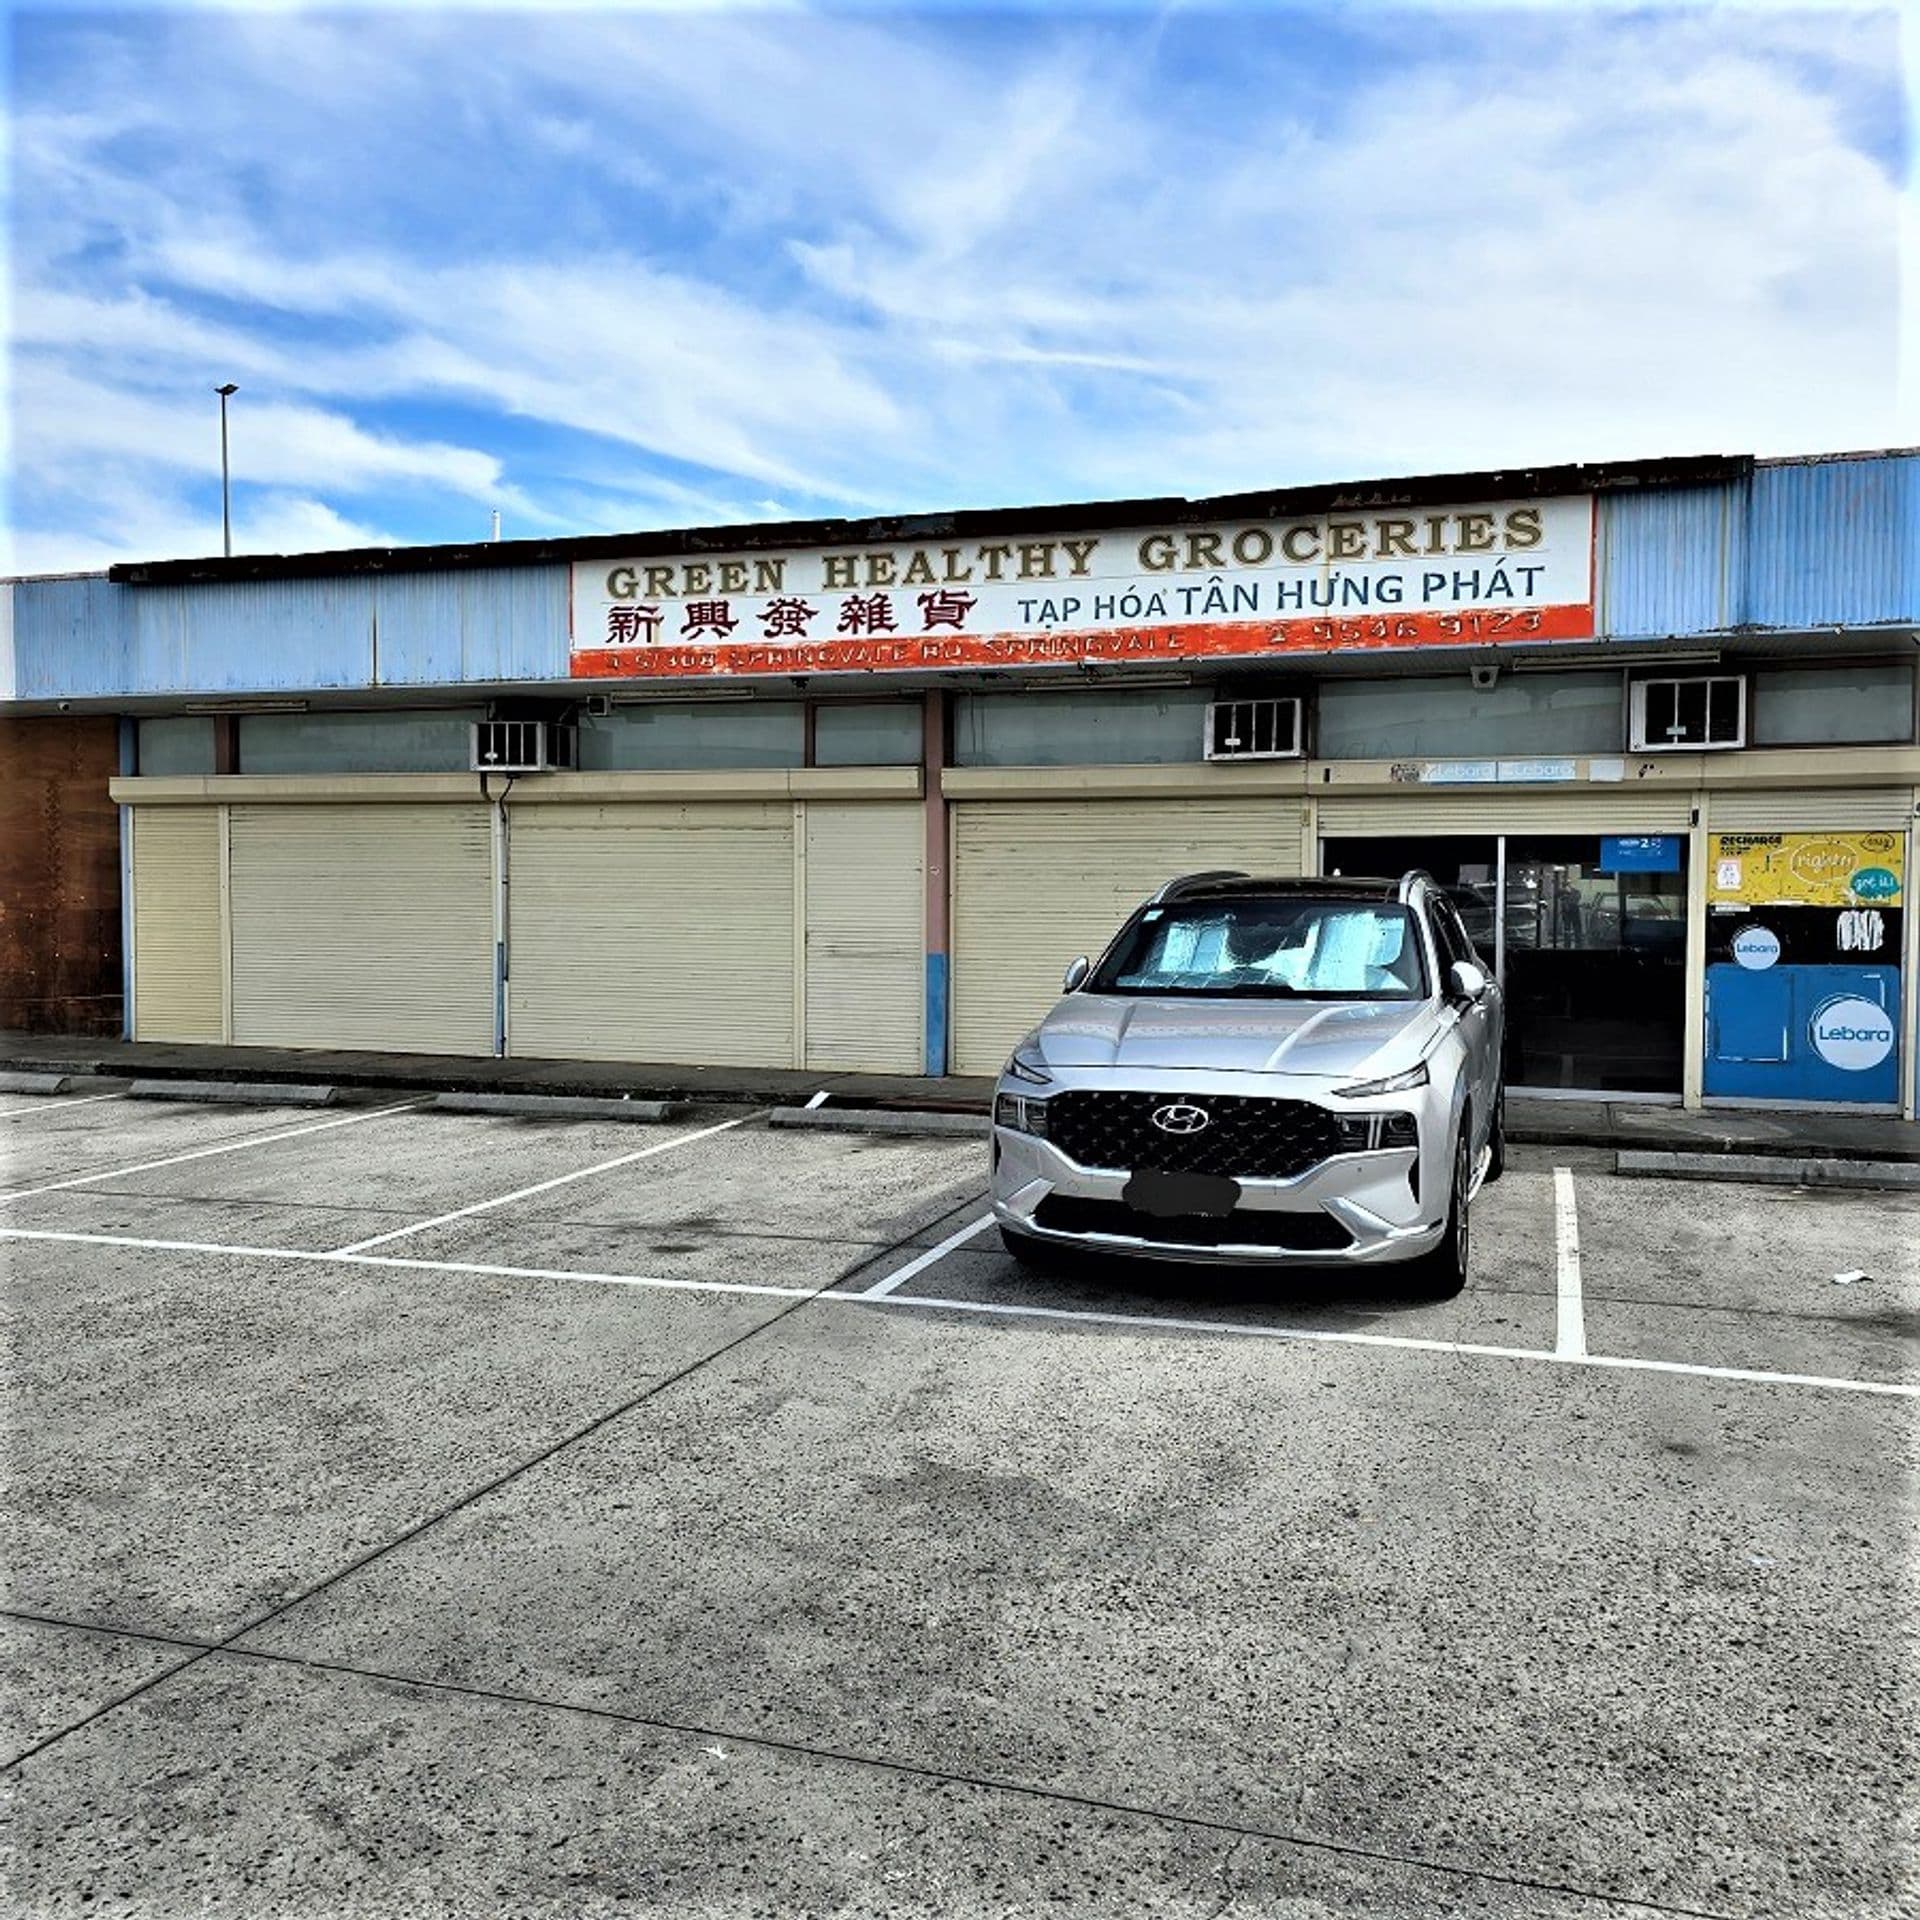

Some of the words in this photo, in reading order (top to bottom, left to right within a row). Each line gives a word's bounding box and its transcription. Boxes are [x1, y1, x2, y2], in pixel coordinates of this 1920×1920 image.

[608, 560, 787, 599] GREEN
[824, 540, 1099, 588] HEALTHY
[1140, 506, 1543, 571] GROCERIES
[1018, 596, 1081, 630] TẠP
[1177, 575, 1259, 616] TÂN
[1423, 557, 1546, 602] PHÁT
[606, 591, 978, 644] 新興發雜貨
[1720, 835, 1782, 846] RECHARGE
[1737, 942, 1778, 954] Lebara
[1819, 1025, 1890, 1042] Lebara
